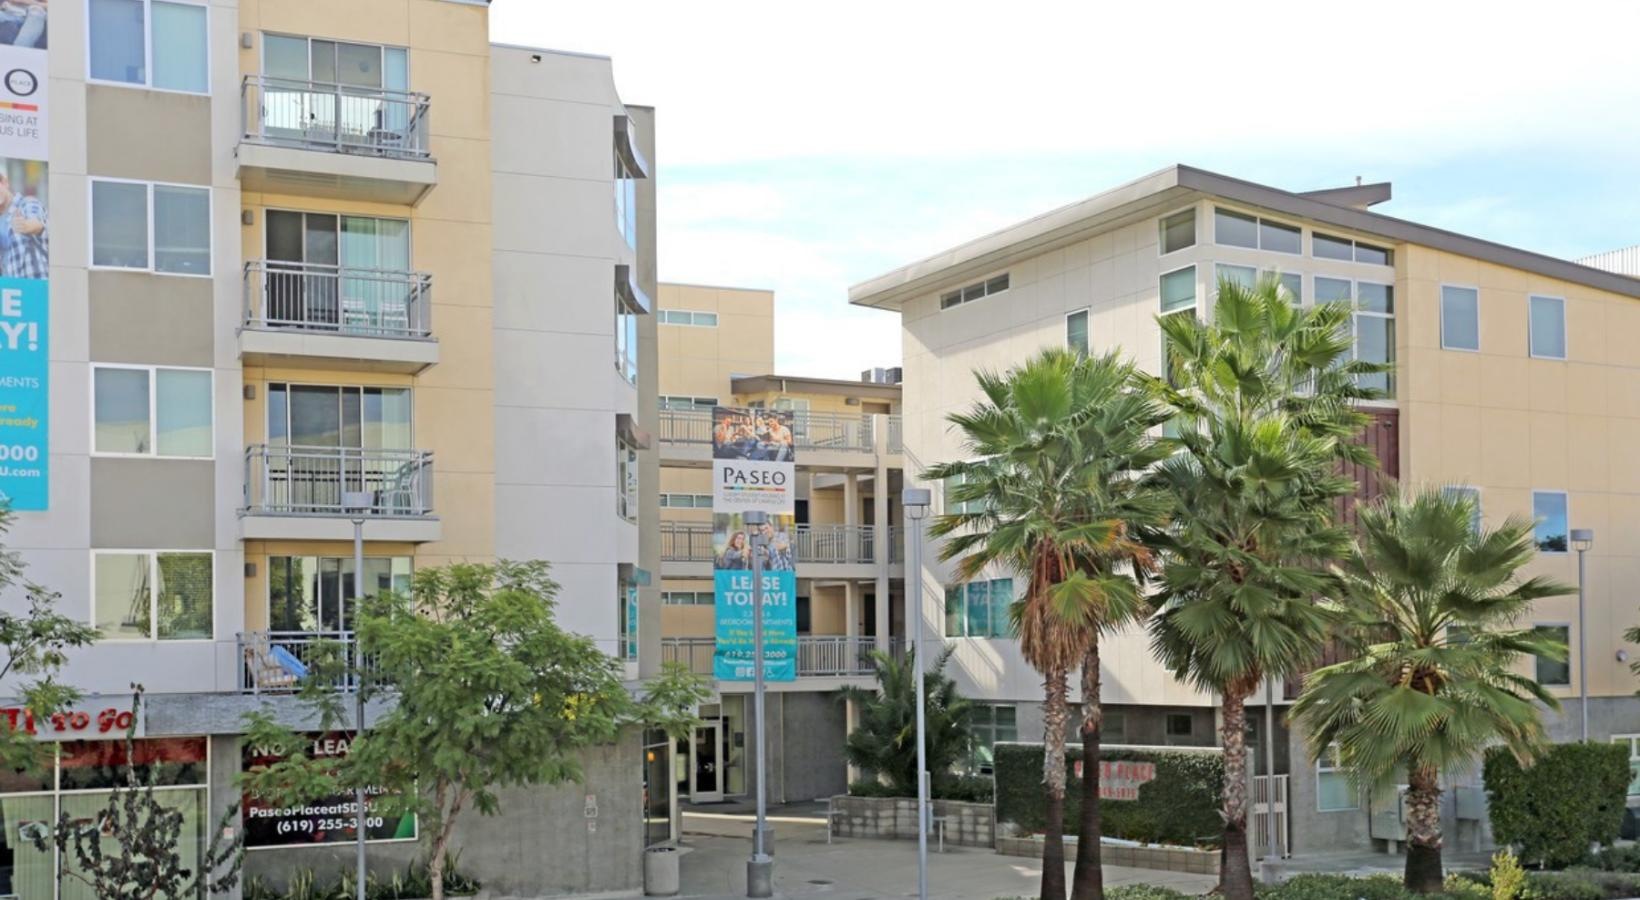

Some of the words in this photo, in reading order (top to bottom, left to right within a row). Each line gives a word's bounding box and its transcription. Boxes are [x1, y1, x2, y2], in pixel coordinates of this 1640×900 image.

[26, 116, 38, 126] AT
[17, 127, 38, 139] LIFE
[723, 467, 786, 485] PASEO
[732, 575, 780, 590] LESE
[313, 739, 354, 755] LEA
[277, 819, 314, 834] (619)
[318, 816, 384, 830] 255-300
